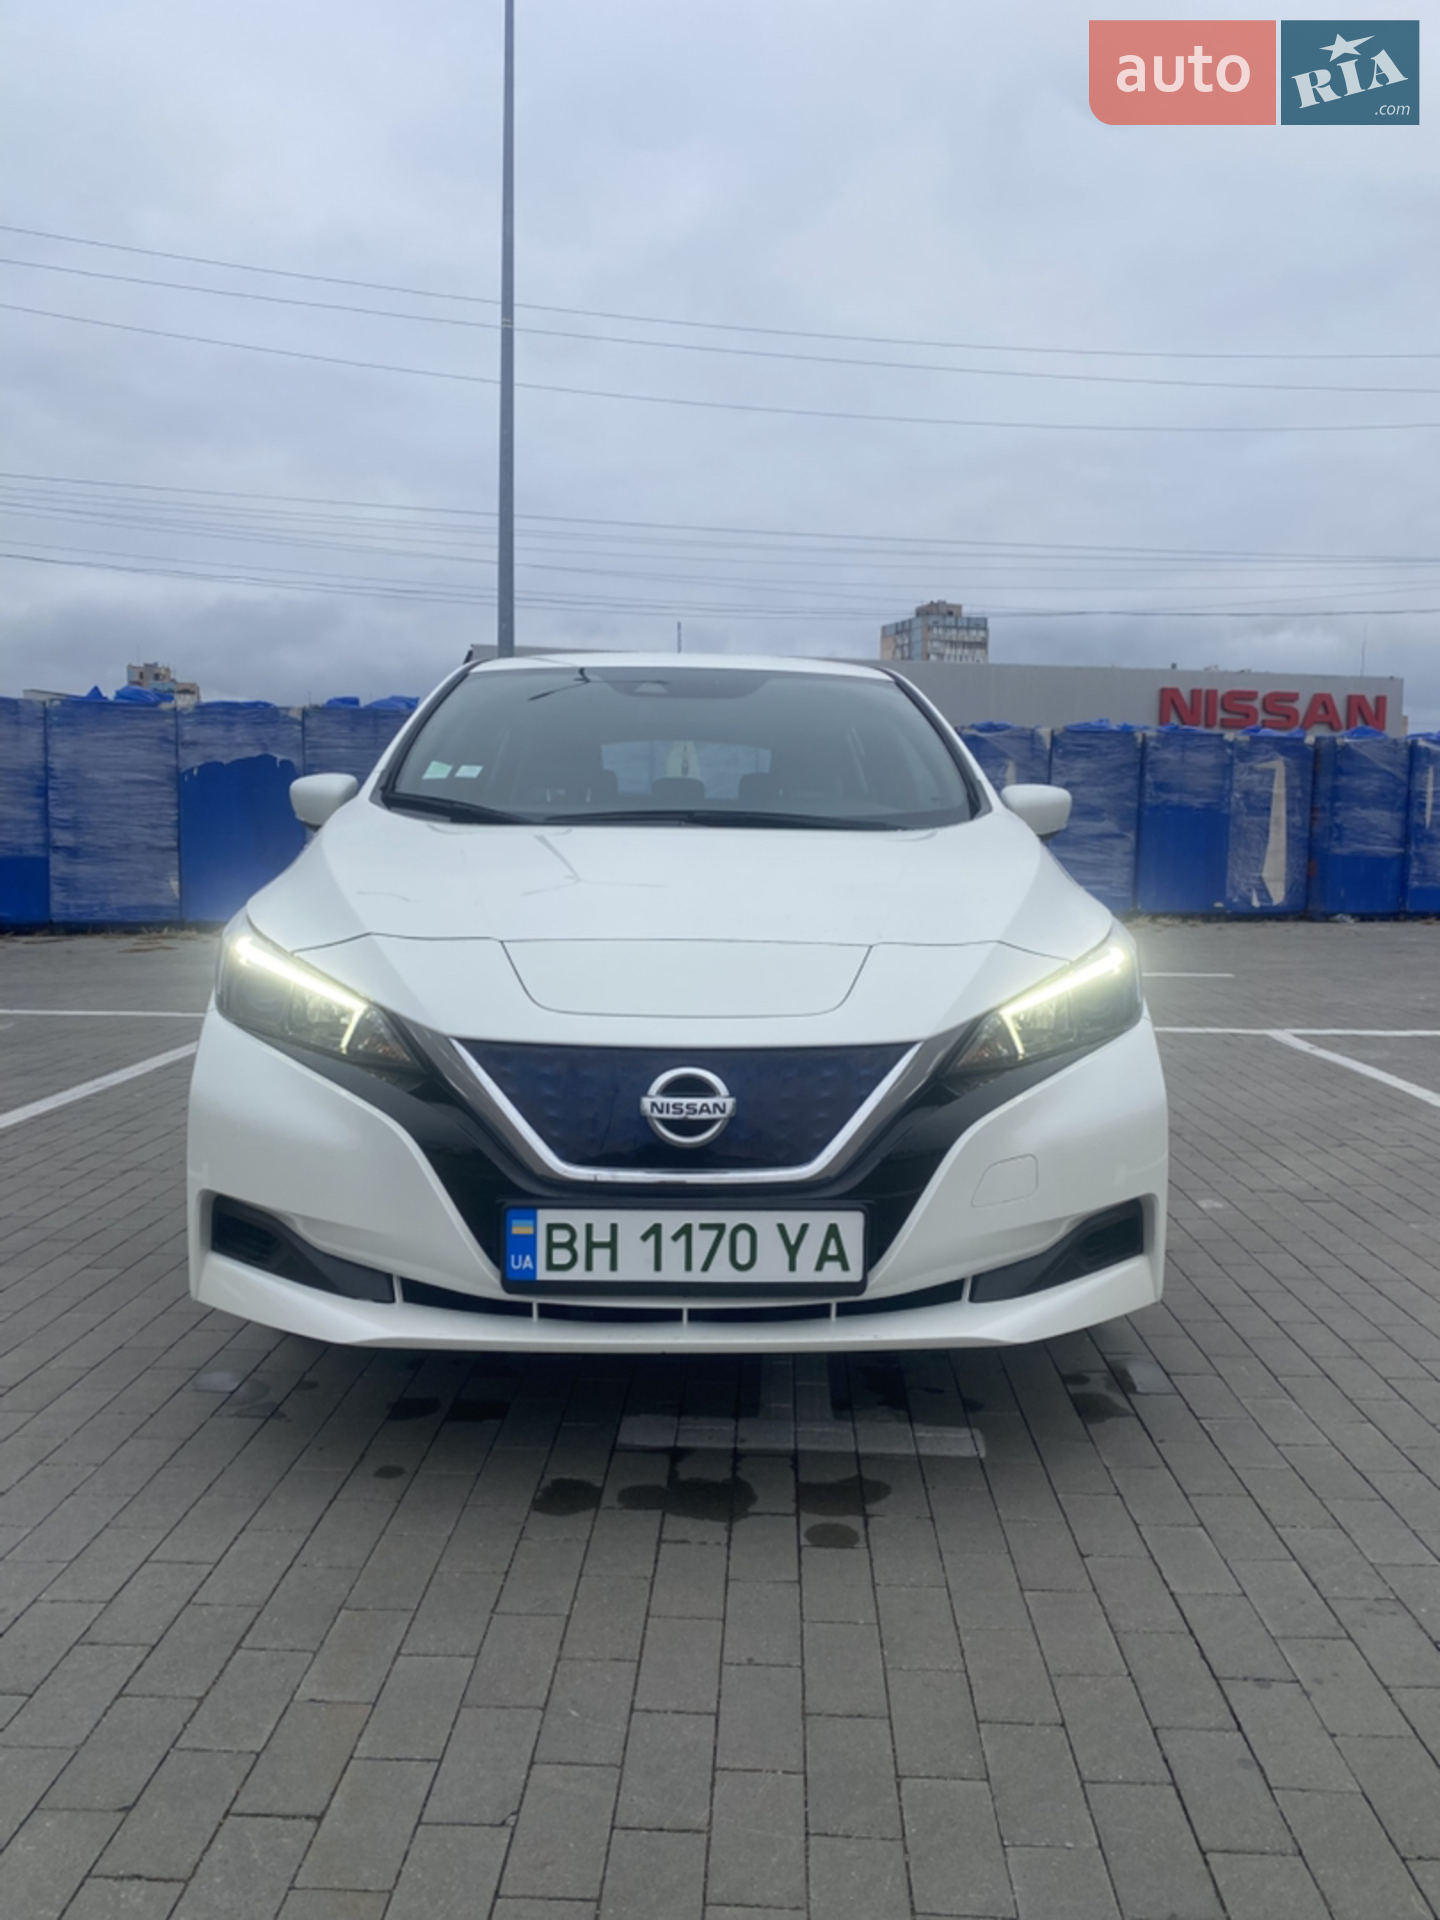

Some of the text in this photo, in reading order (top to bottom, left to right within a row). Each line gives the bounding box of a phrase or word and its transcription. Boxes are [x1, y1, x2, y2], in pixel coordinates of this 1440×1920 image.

[1158, 687, 1388, 732] NISSAN
[649, 1101, 727, 1116] NISSAN
[510, 1254, 534, 1270] UA
[545, 1222, 851, 1273] BH 1170 YA
